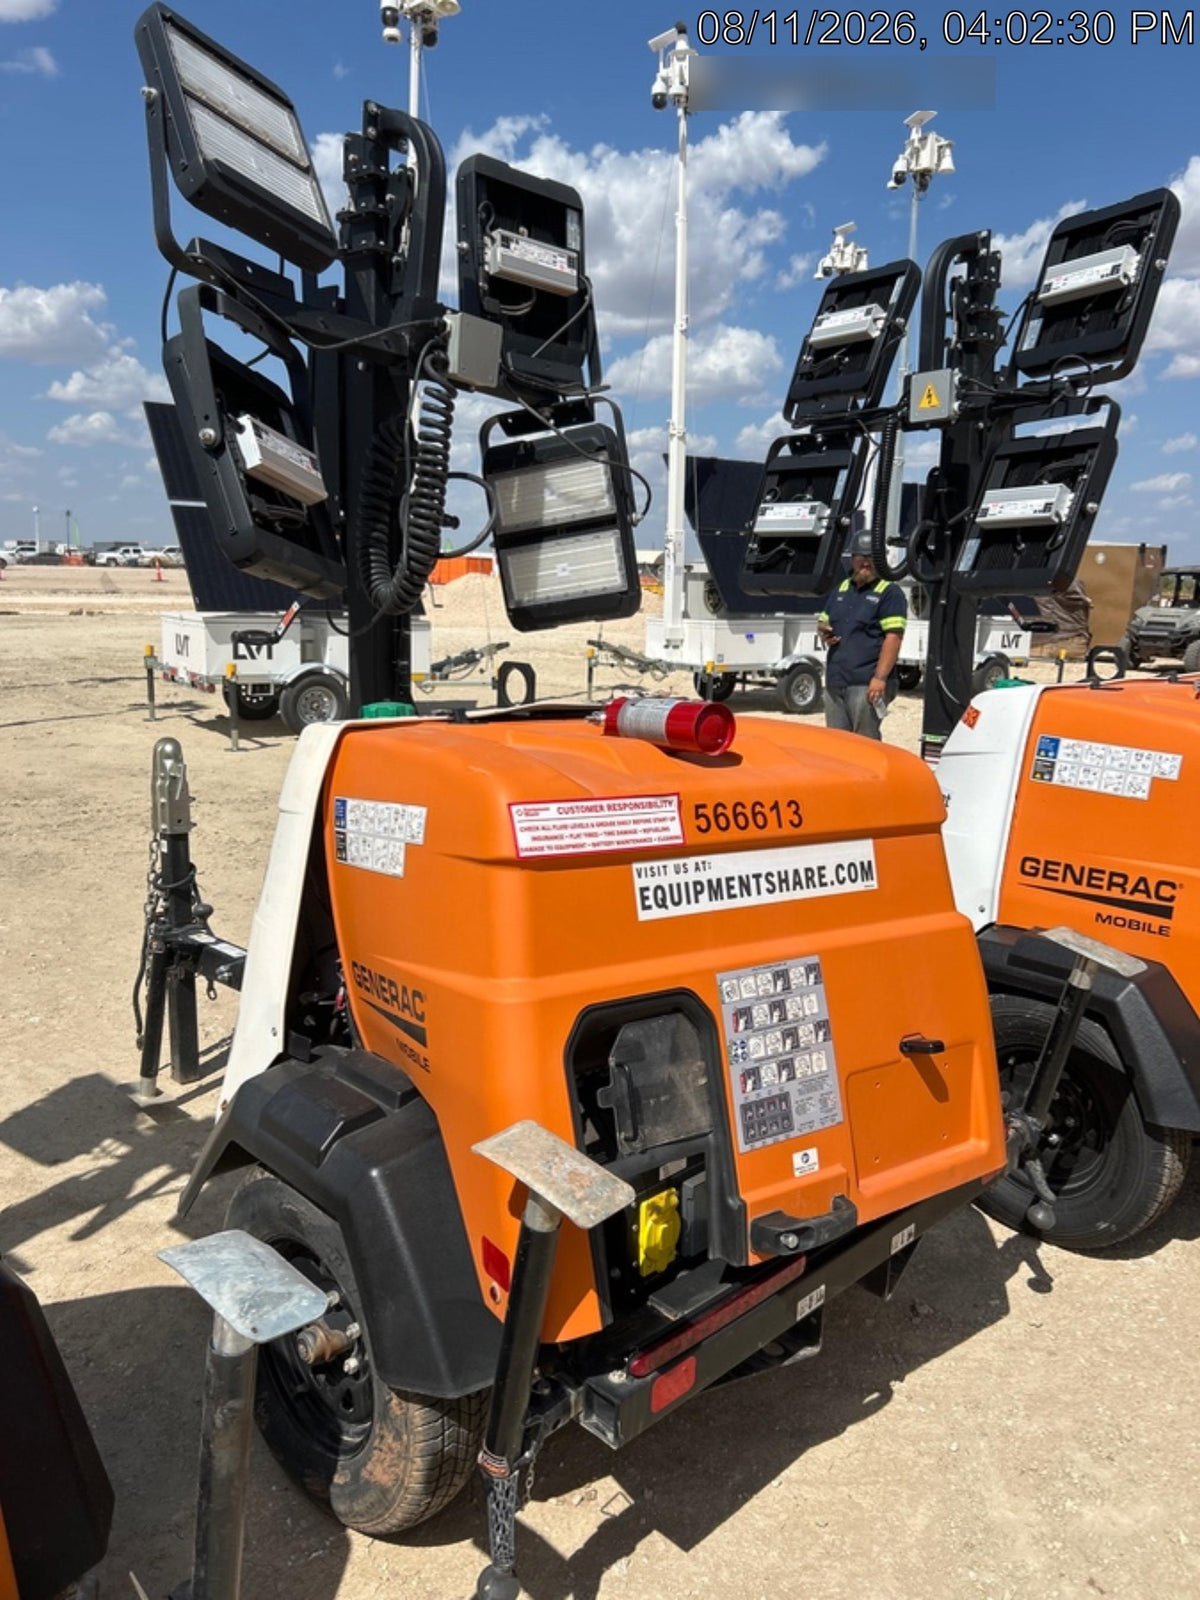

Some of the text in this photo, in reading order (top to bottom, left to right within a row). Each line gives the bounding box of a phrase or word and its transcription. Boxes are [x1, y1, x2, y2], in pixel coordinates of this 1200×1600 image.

[557, 805, 604, 815] CUSTOMER
[606, 800, 674, 811] RESPONSIBILITY
[694, 799, 804, 834] 566613
[636, 860, 712, 879] VISIT US AT:
[638, 860, 874, 911] EQUIPMENTSHARE.COM
[1019, 855, 1178, 904] GENERAC
[1094, 911, 1172, 938] MOBILE
[351, 960, 427, 1023] GENERAC
[395, 1038, 432, 1074] MOBILE
